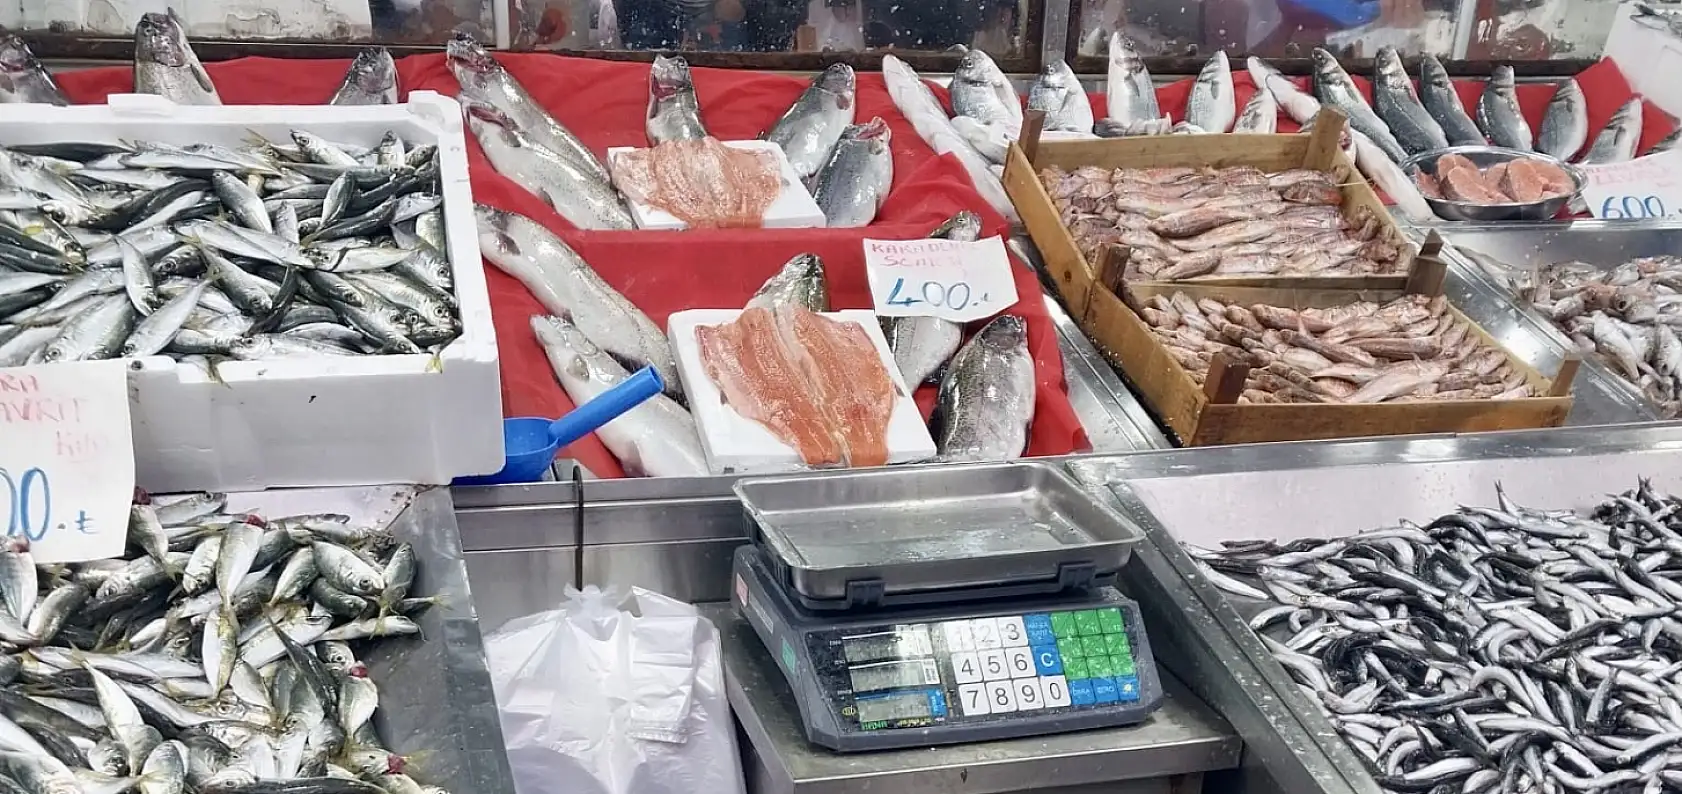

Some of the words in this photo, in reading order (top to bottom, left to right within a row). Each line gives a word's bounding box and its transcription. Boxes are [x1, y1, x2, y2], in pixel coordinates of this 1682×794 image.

[979, 624, 996, 643] 2
[1005, 623, 1020, 641] 3
[961, 658, 975, 676] 4
[987, 655, 1001, 674] 5
[1013, 653, 1028, 671] 6
[1040, 652, 1055, 668] C
[966, 689, 979, 709] 7
[994, 687, 1009, 706] 8
[1021, 684, 1036, 703] 9
[1049, 682, 1061, 700] 0
